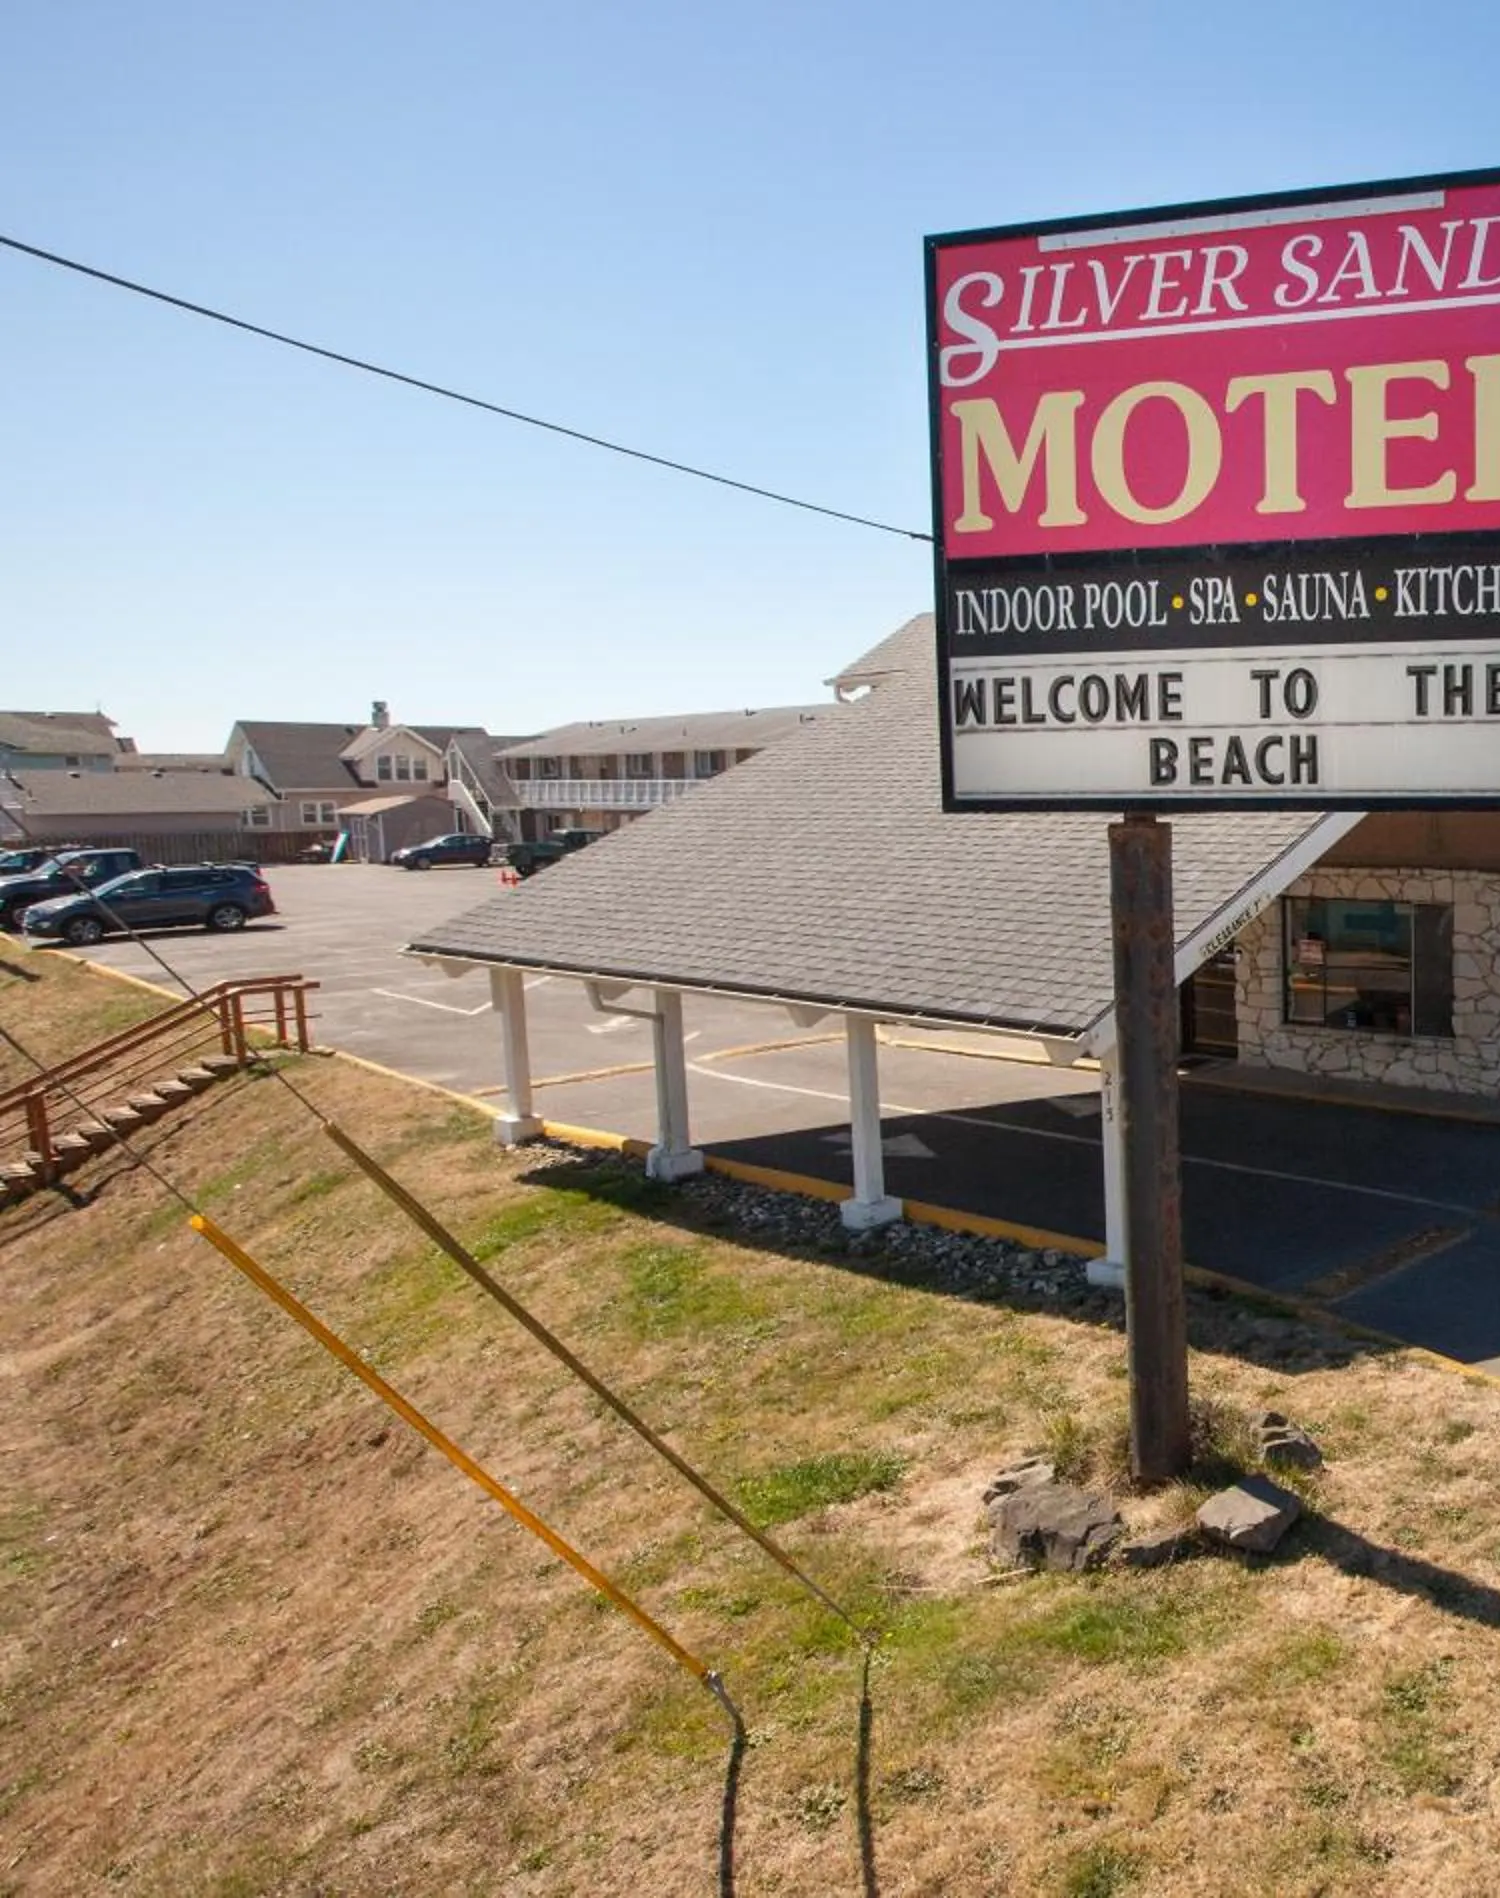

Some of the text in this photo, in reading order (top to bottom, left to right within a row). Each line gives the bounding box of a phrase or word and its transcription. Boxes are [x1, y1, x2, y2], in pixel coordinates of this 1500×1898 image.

[939, 246, 1248, 387] SILVER
[955, 586, 1078, 635] INDOOR
[1083, 579, 1168, 629] POOL
[1189, 576, 1241, 625] SPA
[1263, 569, 1371, 622] SAUNA
[953, 671, 1183, 727] WELCOME
[1250, 667, 1319, 719] TO
[1149, 734, 1319, 787] BEACH
